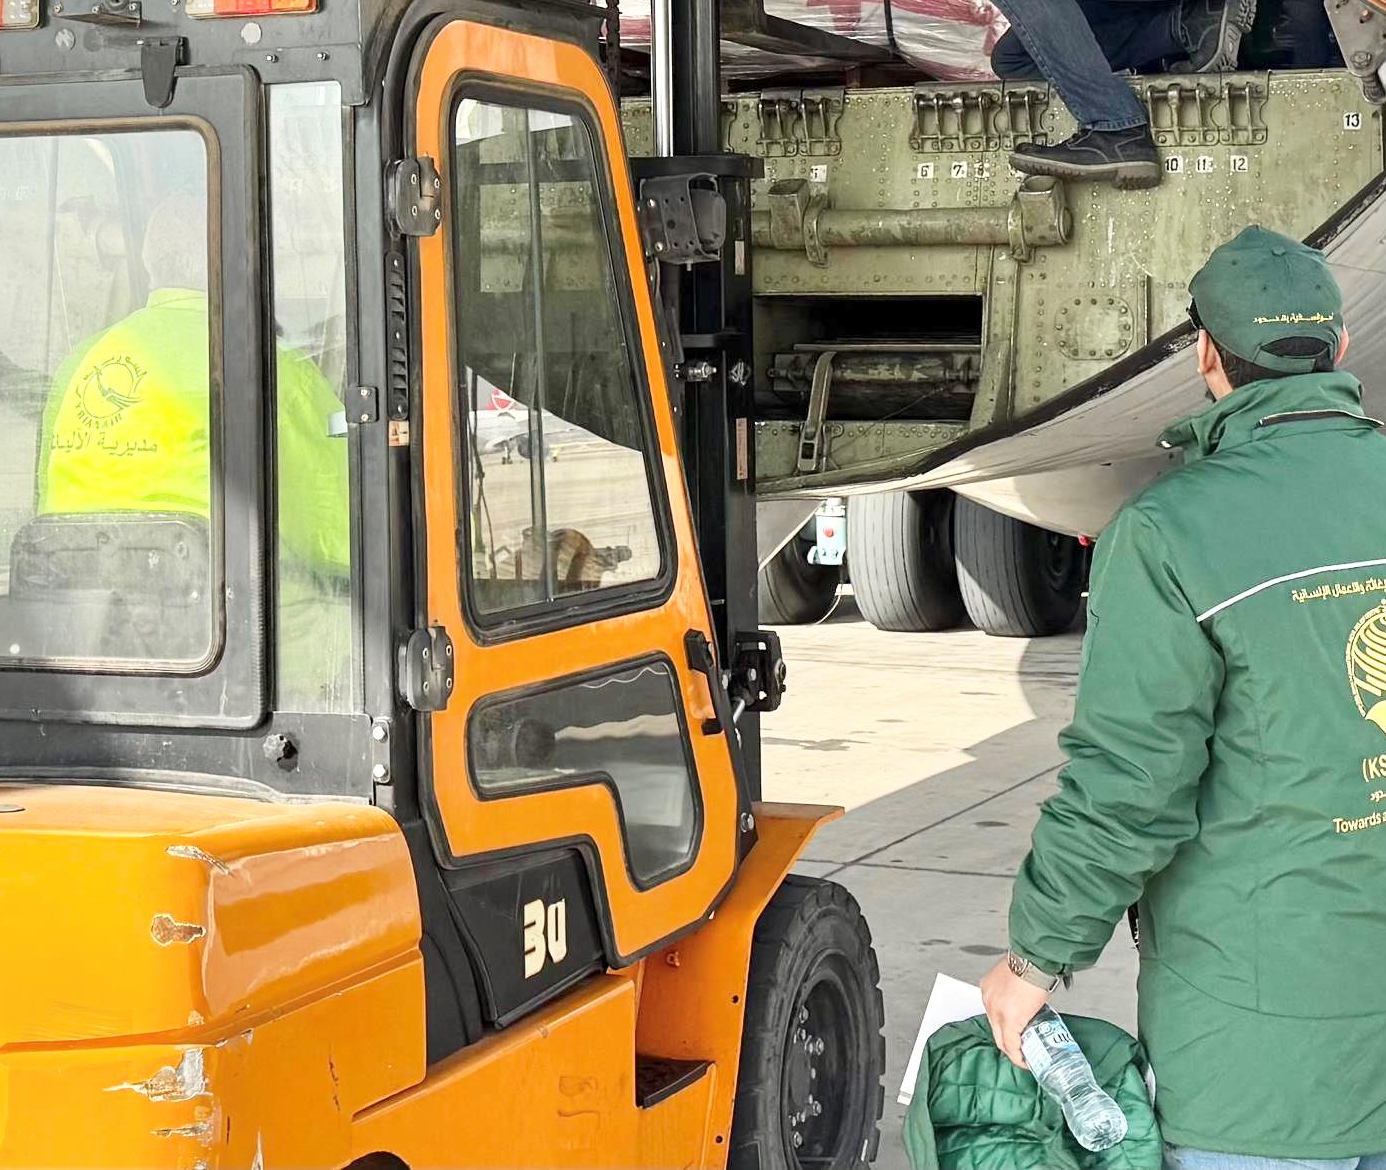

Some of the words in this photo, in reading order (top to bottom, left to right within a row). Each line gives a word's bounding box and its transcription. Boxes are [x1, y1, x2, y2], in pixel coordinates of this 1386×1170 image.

[1345, 114, 1360, 128] 13
[1165, 157, 1179, 171] 10
[1232, 157, 1246, 172] 12
[1332, 811, 1382, 834] Towards
[523, 897, 568, 980] 30
